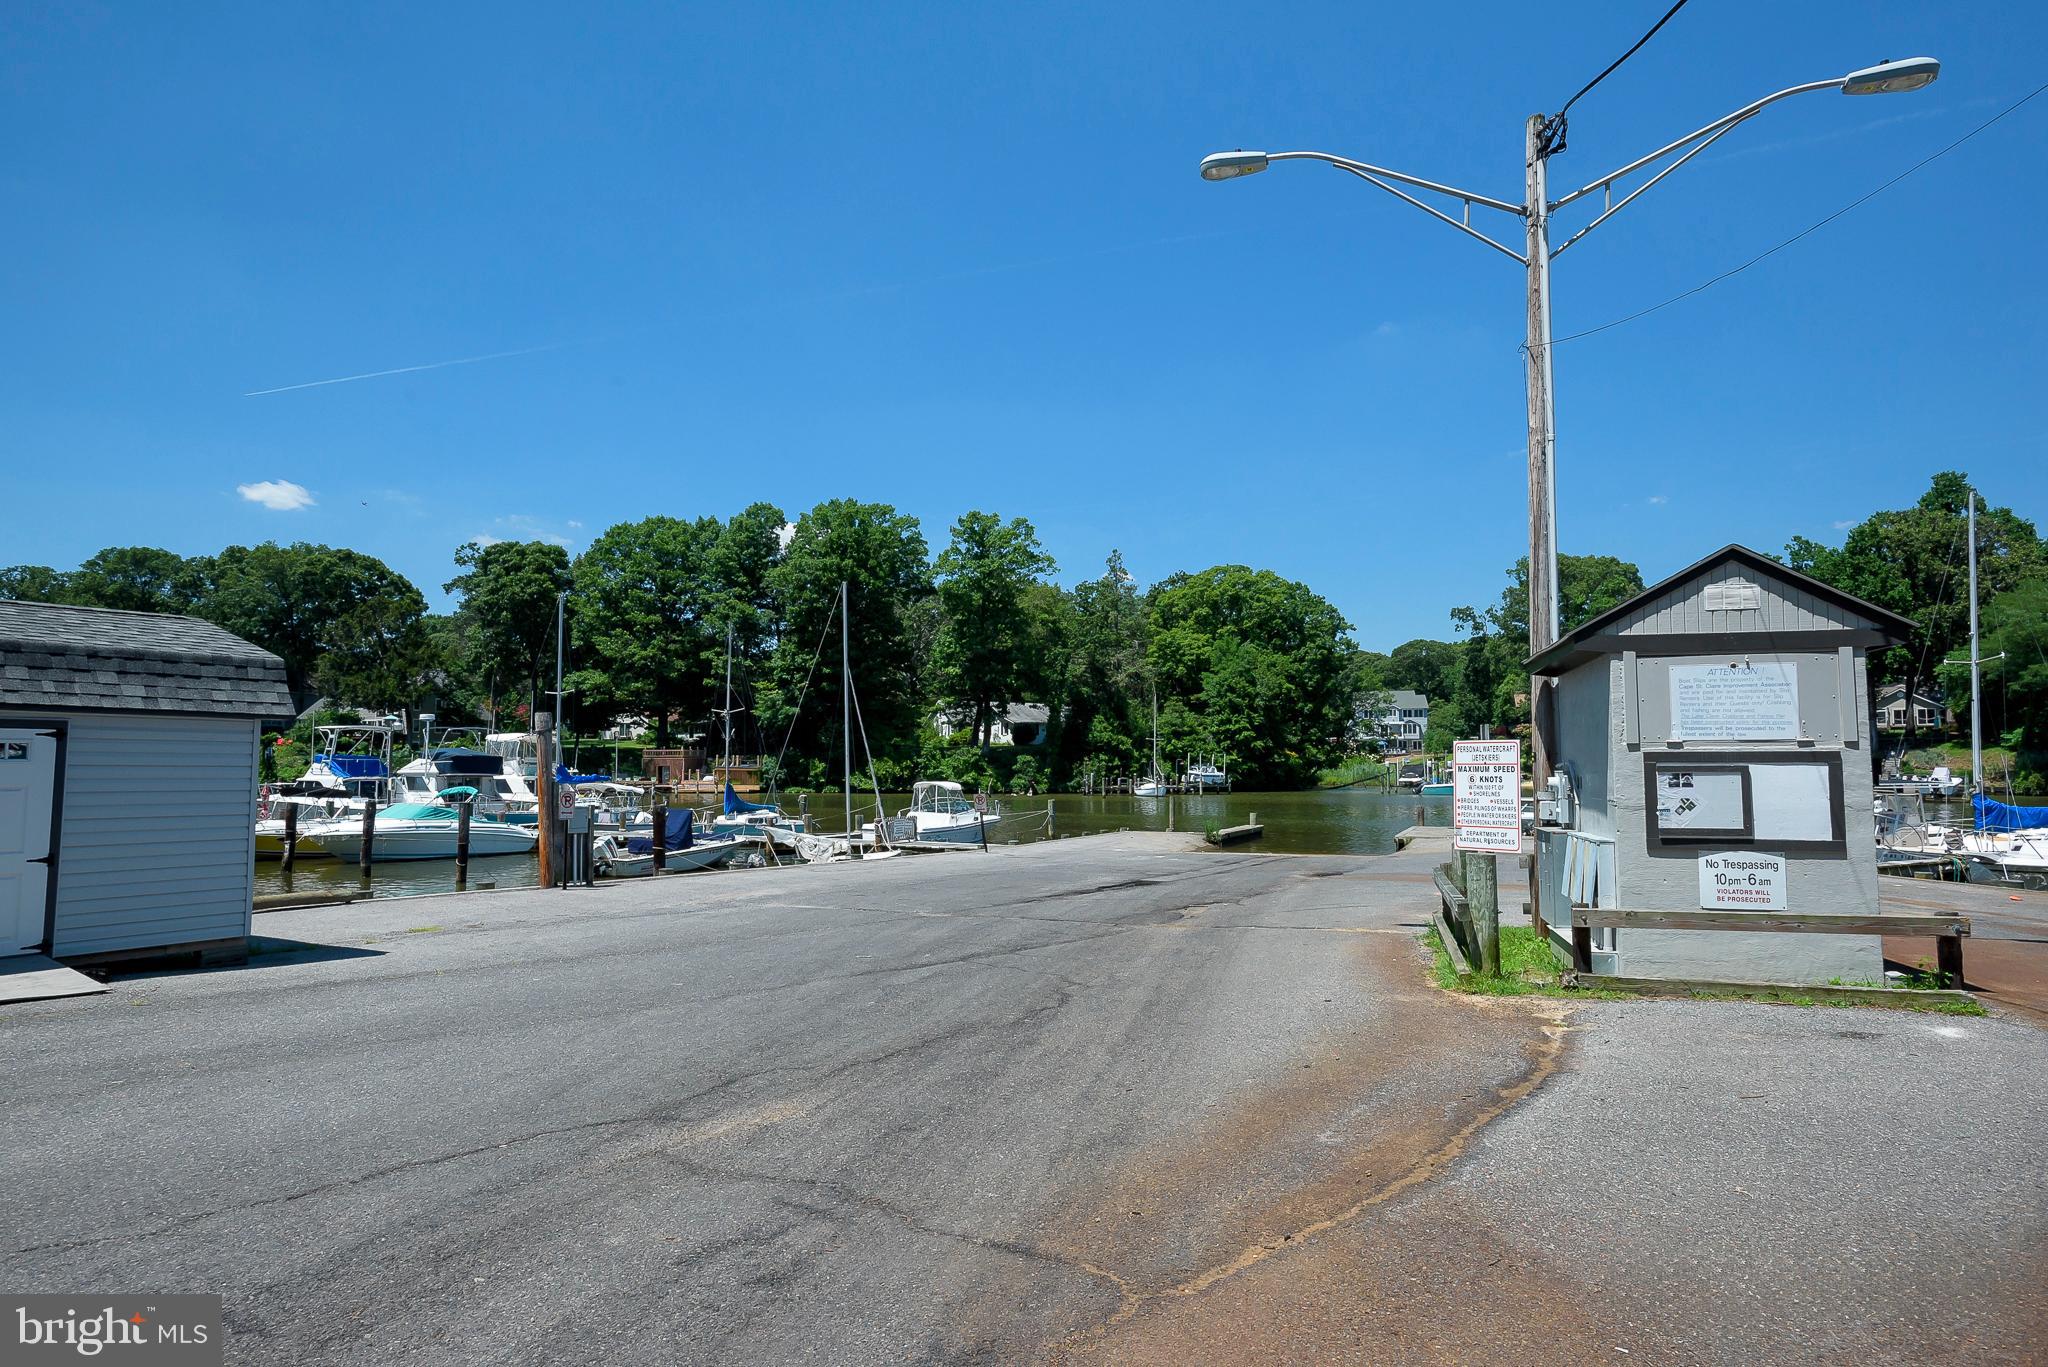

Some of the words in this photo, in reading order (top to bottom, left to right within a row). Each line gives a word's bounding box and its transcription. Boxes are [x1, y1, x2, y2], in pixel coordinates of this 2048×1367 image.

[1707, 668, 1758, 676] ATTENTION
[1706, 859, 1719, 868] No
[1722, 859, 1779, 872] Trespassing
